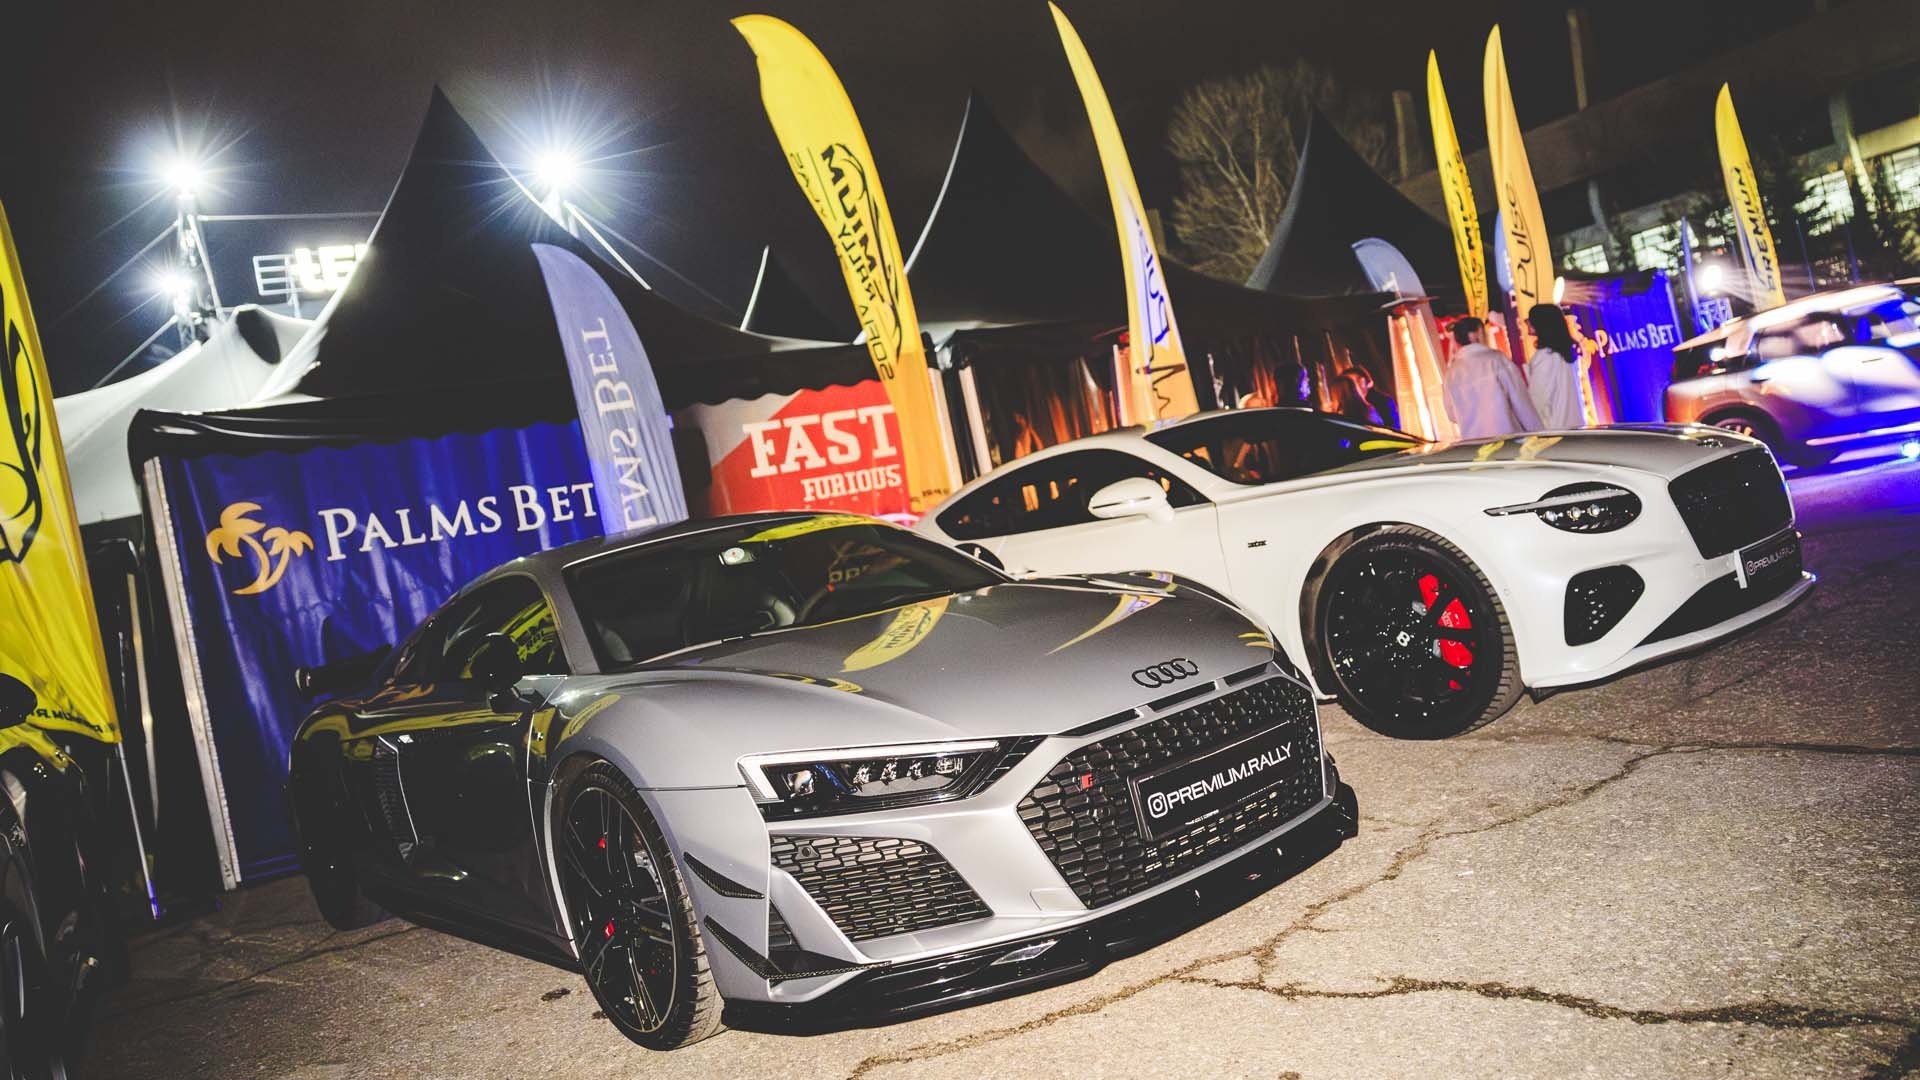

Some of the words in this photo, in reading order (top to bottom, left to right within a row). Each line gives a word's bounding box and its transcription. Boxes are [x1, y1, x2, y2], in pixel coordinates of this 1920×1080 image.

[1594, 328, 1649, 358] PALMS
[1646, 322, 1674, 349] BET
[742, 404, 898, 479] FAST
[801, 463, 902, 502] FURIOUS
[318, 495, 502, 562] PALMS
[508, 482, 597, 532] BET
[1166, 741, 1292, 809] PREMIUM.RALLY
